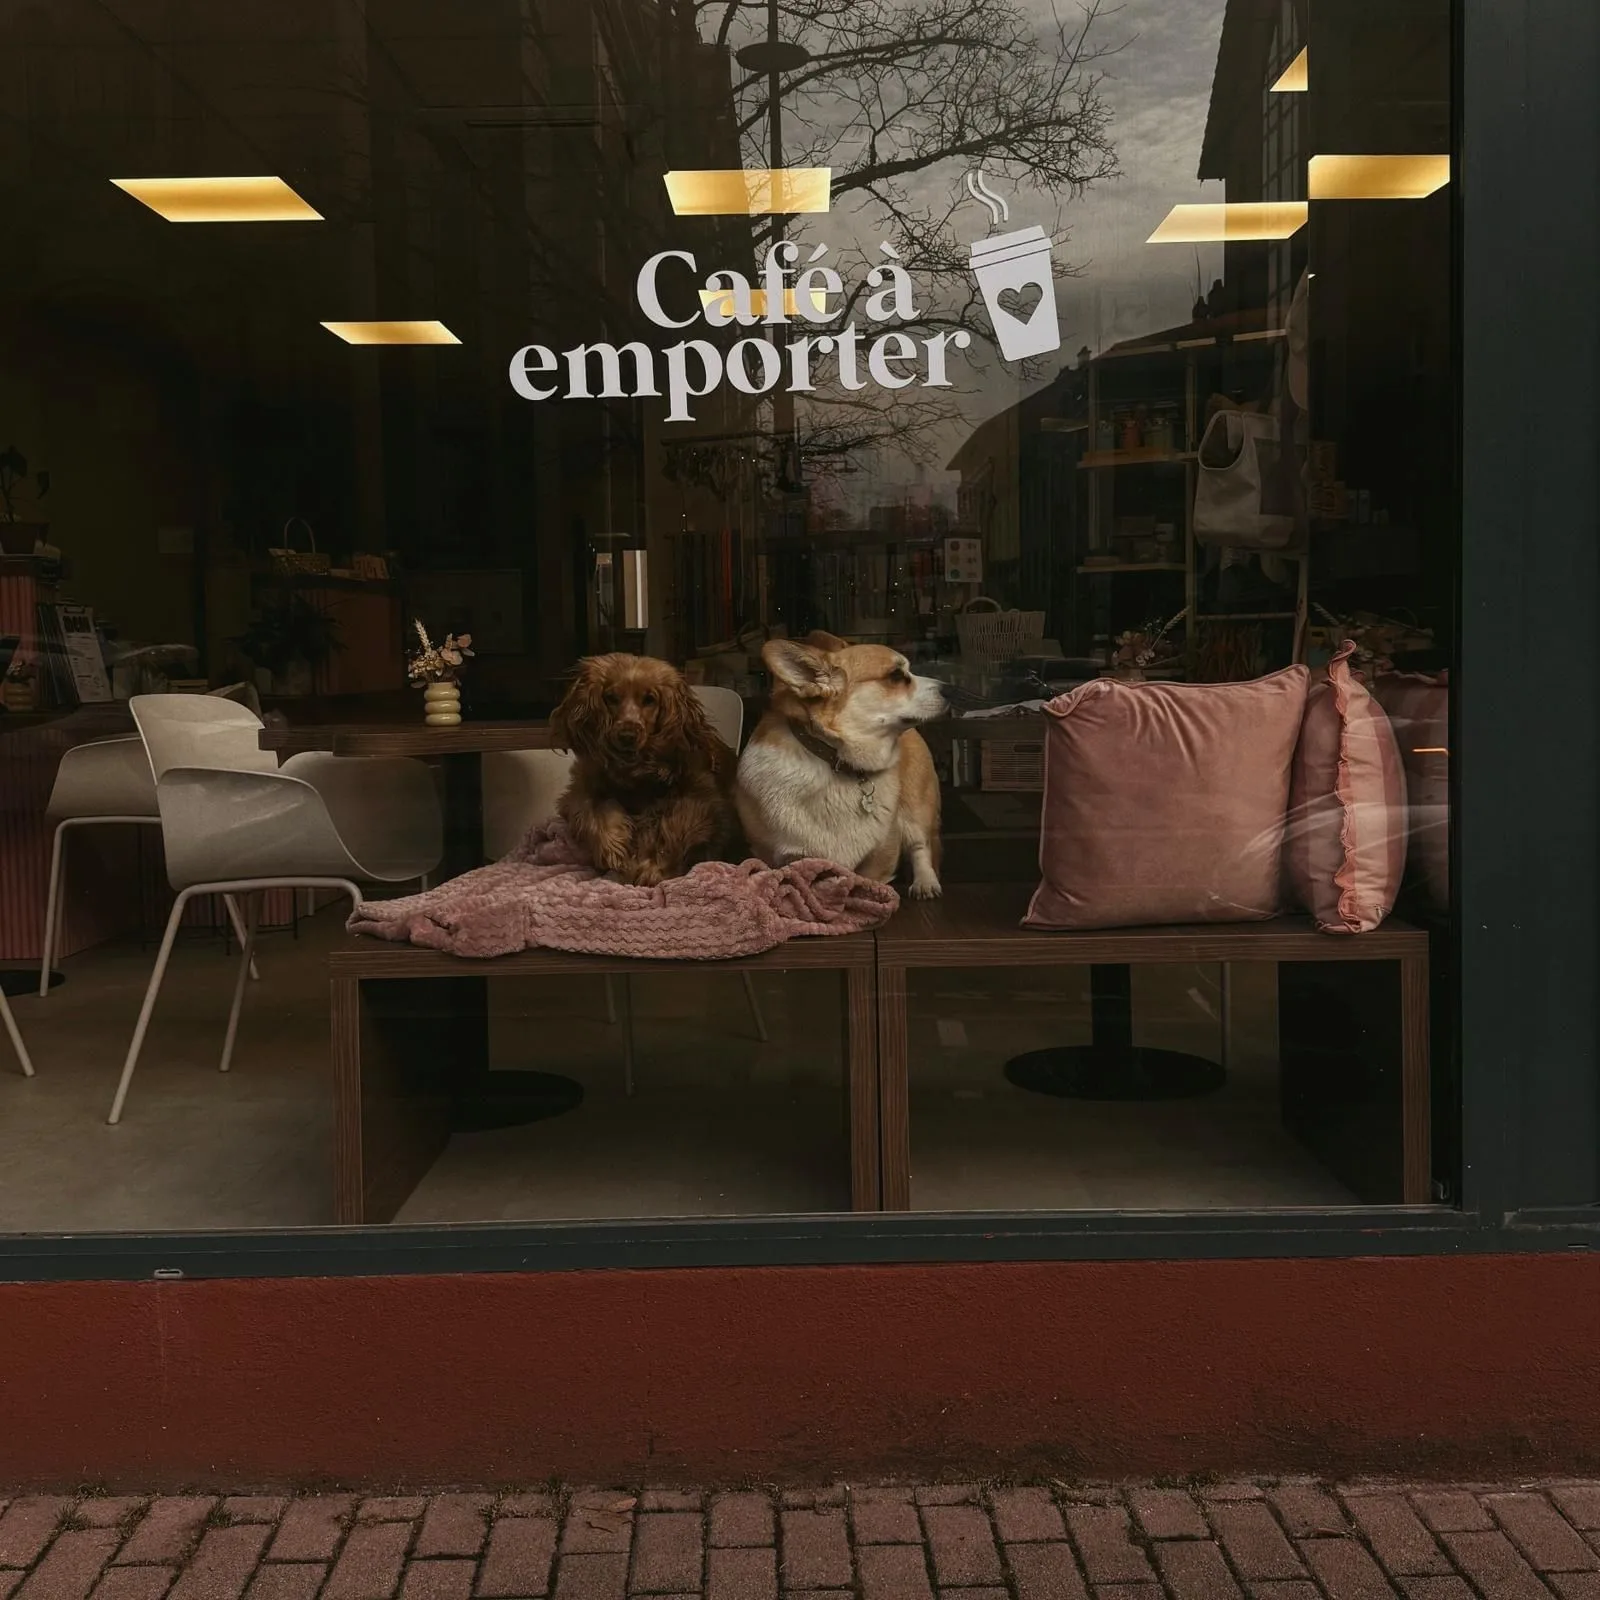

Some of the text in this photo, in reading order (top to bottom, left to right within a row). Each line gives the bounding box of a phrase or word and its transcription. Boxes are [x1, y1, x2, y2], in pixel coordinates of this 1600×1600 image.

[636, 240, 921, 328] Café à
[509, 321, 971, 422] emporter
